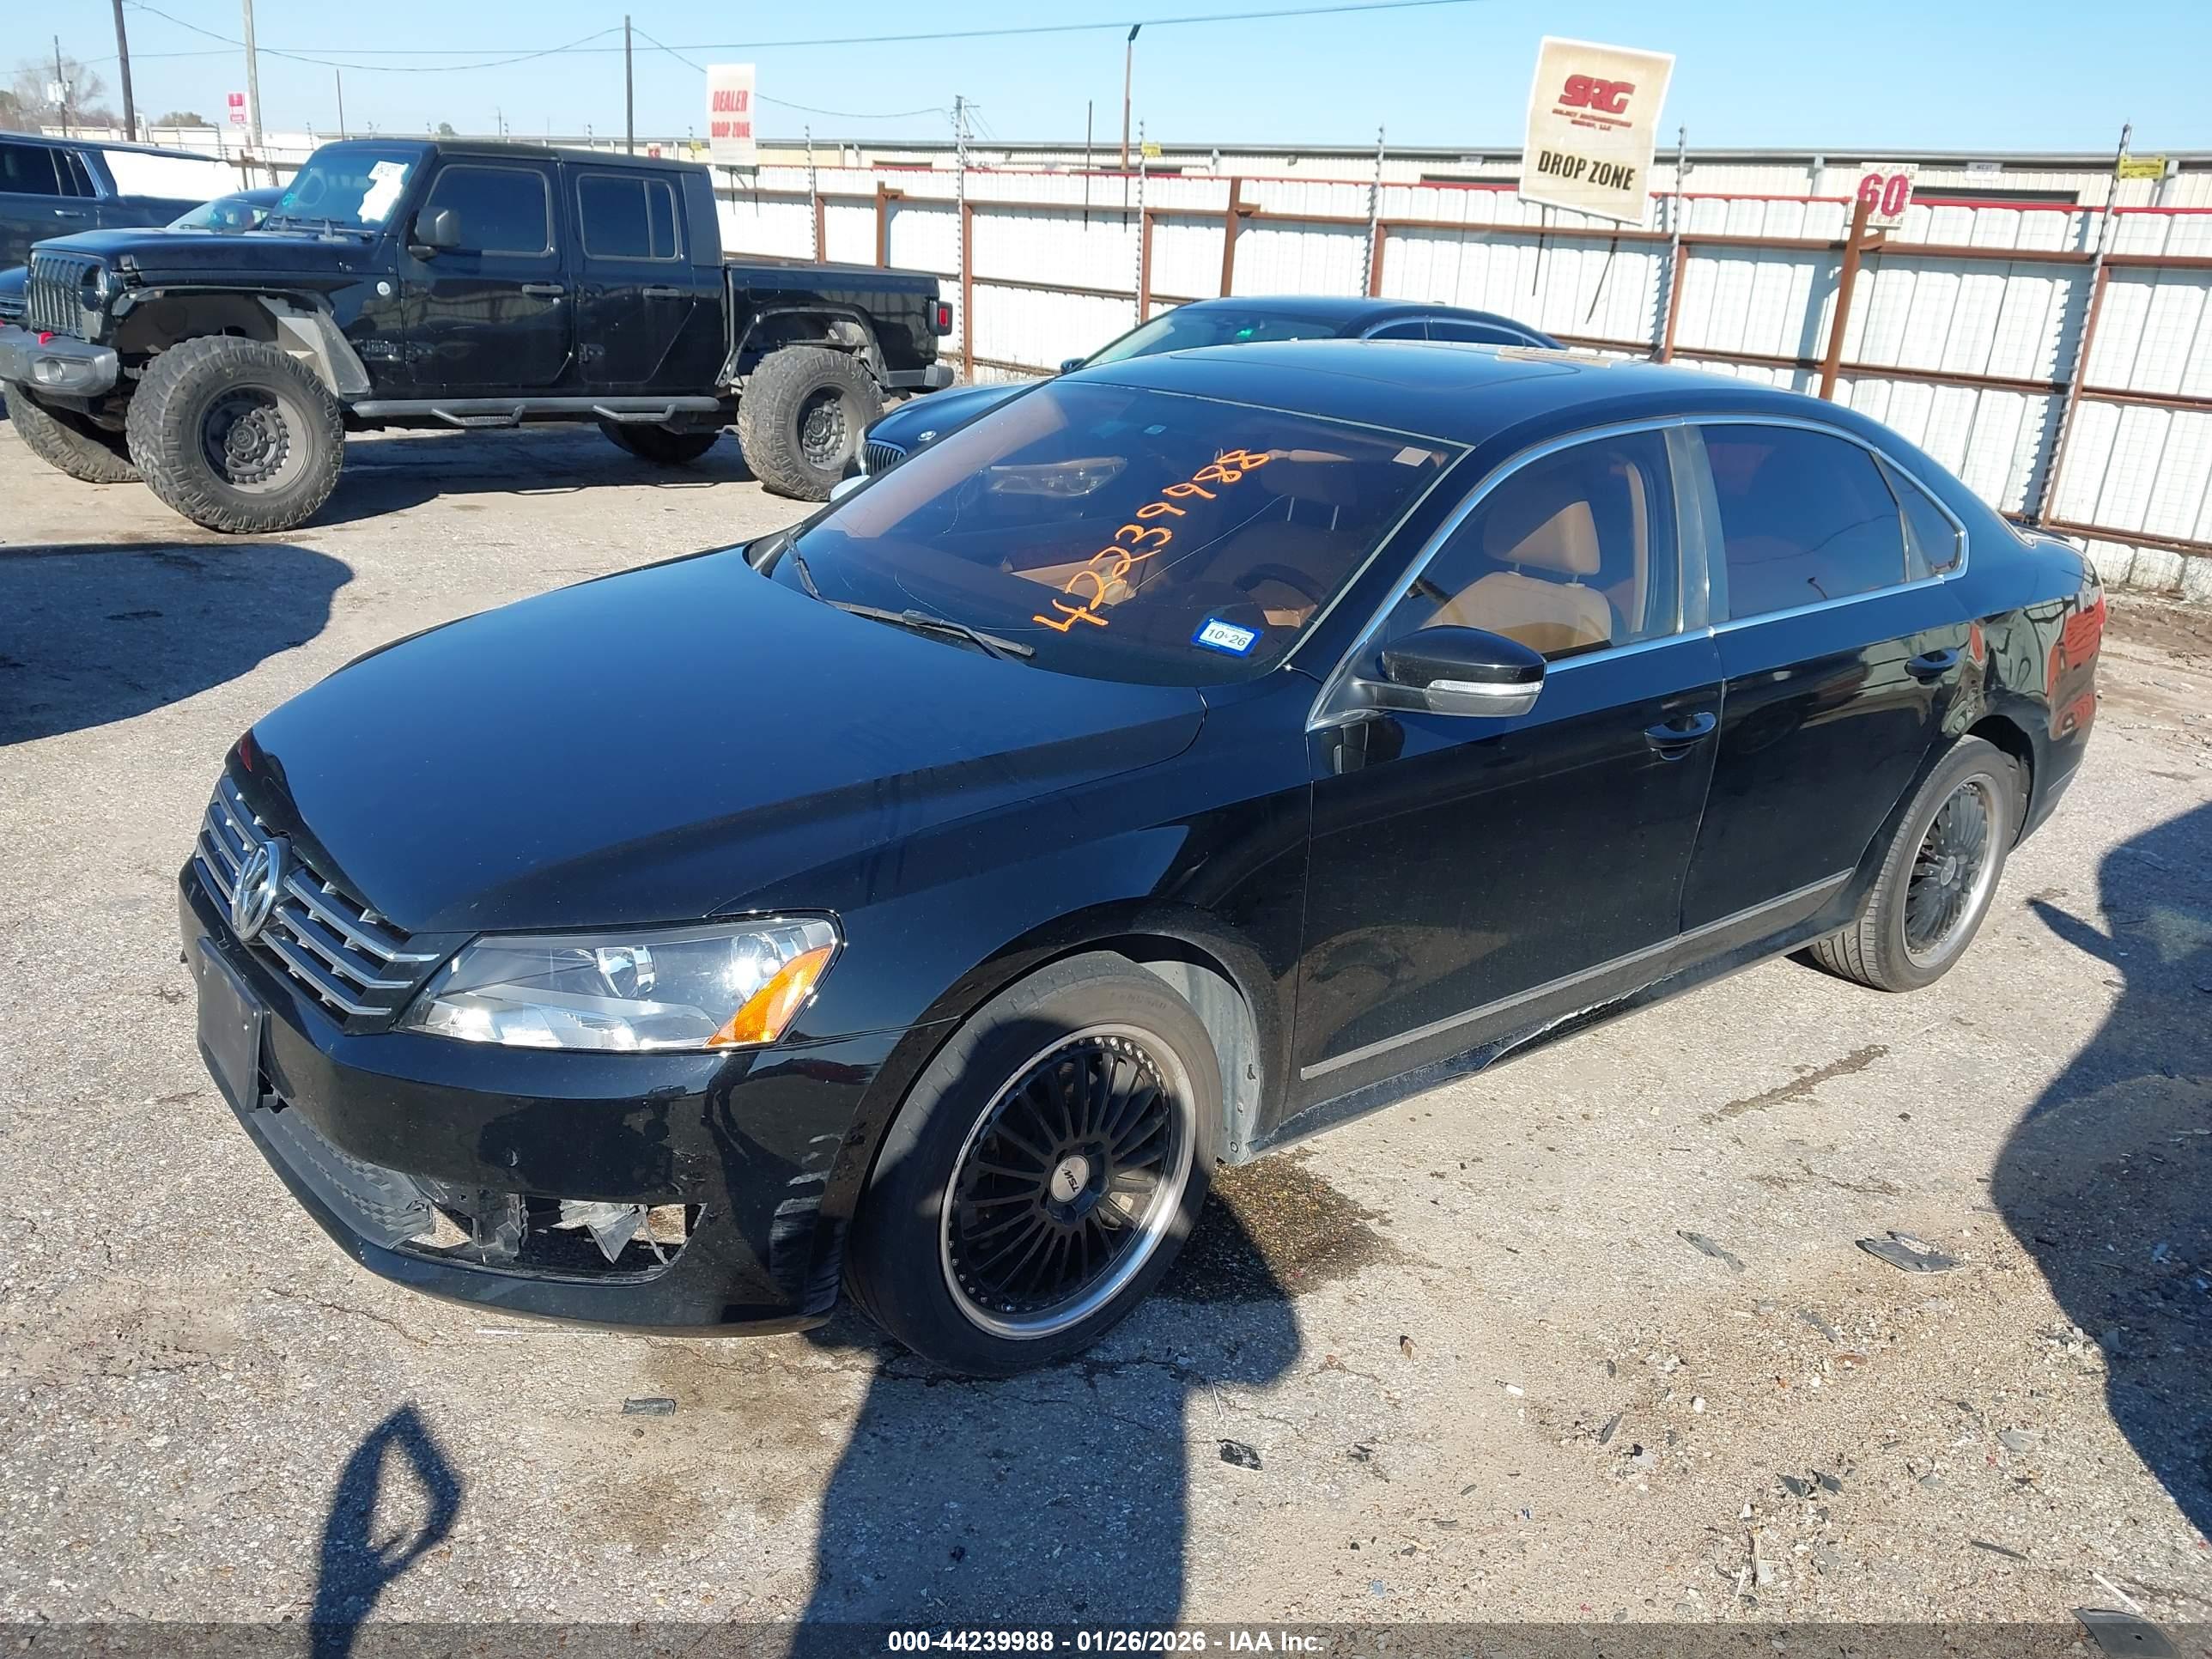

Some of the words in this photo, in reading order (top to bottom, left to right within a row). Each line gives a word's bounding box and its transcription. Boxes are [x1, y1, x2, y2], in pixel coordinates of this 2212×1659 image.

[713, 89, 748, 112] DEALER
[1559, 74, 1635, 114] SRG
[711, 121, 730, 138] DROP
[732, 121, 750, 138] ZONE
[1537, 150, 1587, 179] DROP
[1588, 161, 1636, 191] ZONE
[1857, 173, 1909, 216] 60
[1061, 1168, 1079, 1193] TSW
